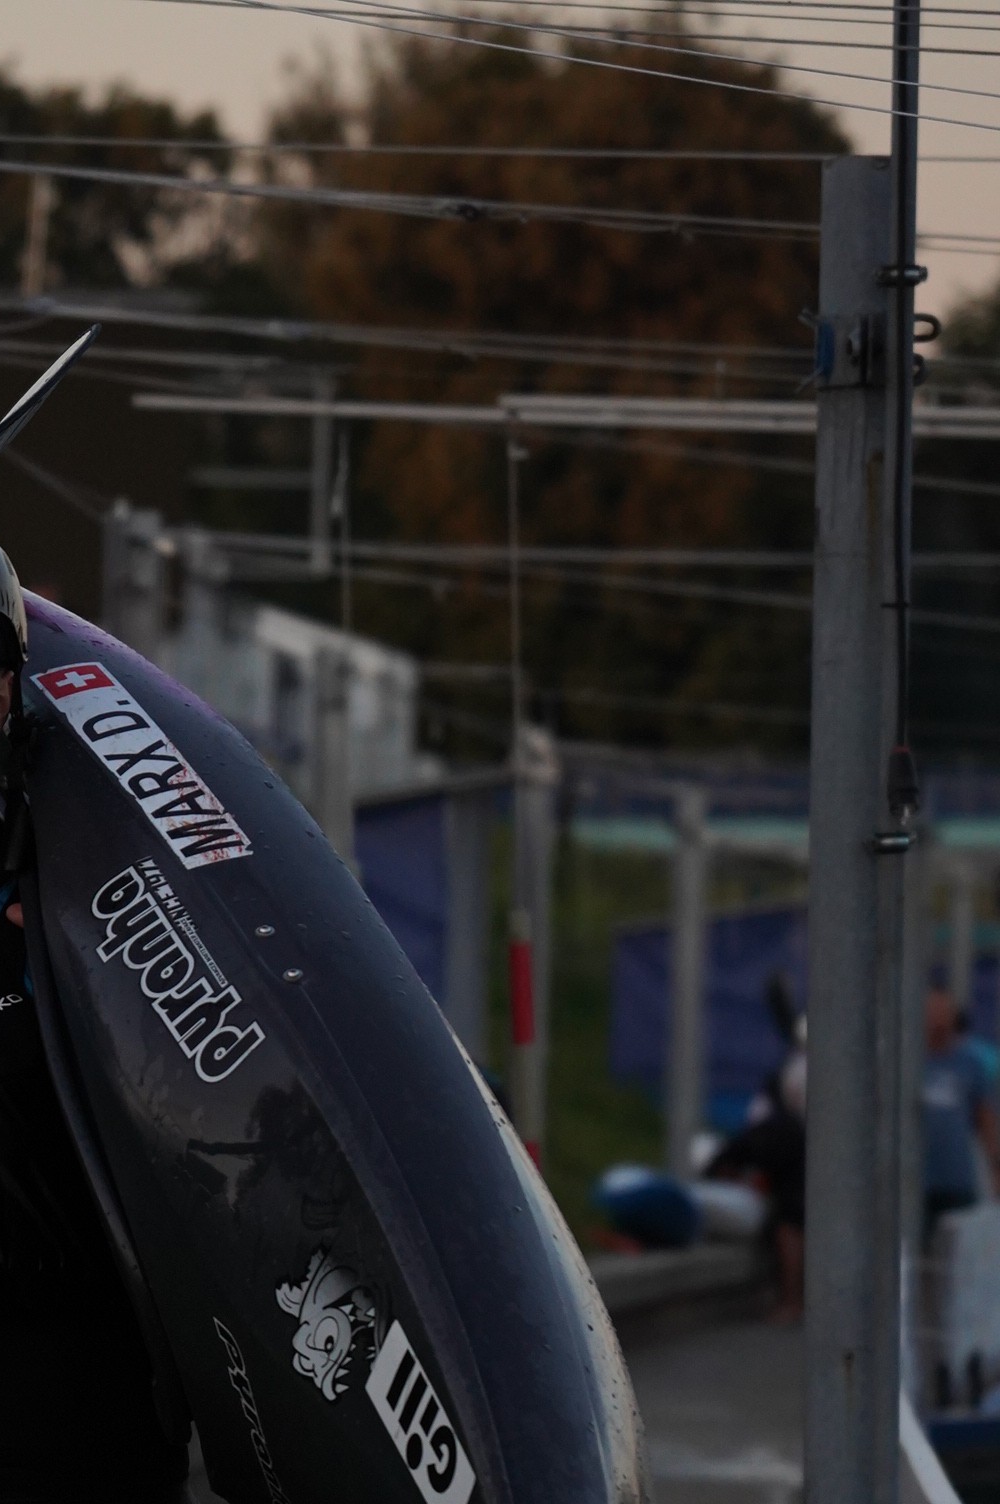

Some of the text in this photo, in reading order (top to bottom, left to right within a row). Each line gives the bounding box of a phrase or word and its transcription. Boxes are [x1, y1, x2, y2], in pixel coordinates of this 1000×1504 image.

[82, 699, 245, 858] MARX D.
[386, 1349, 458, 1494] Gill
